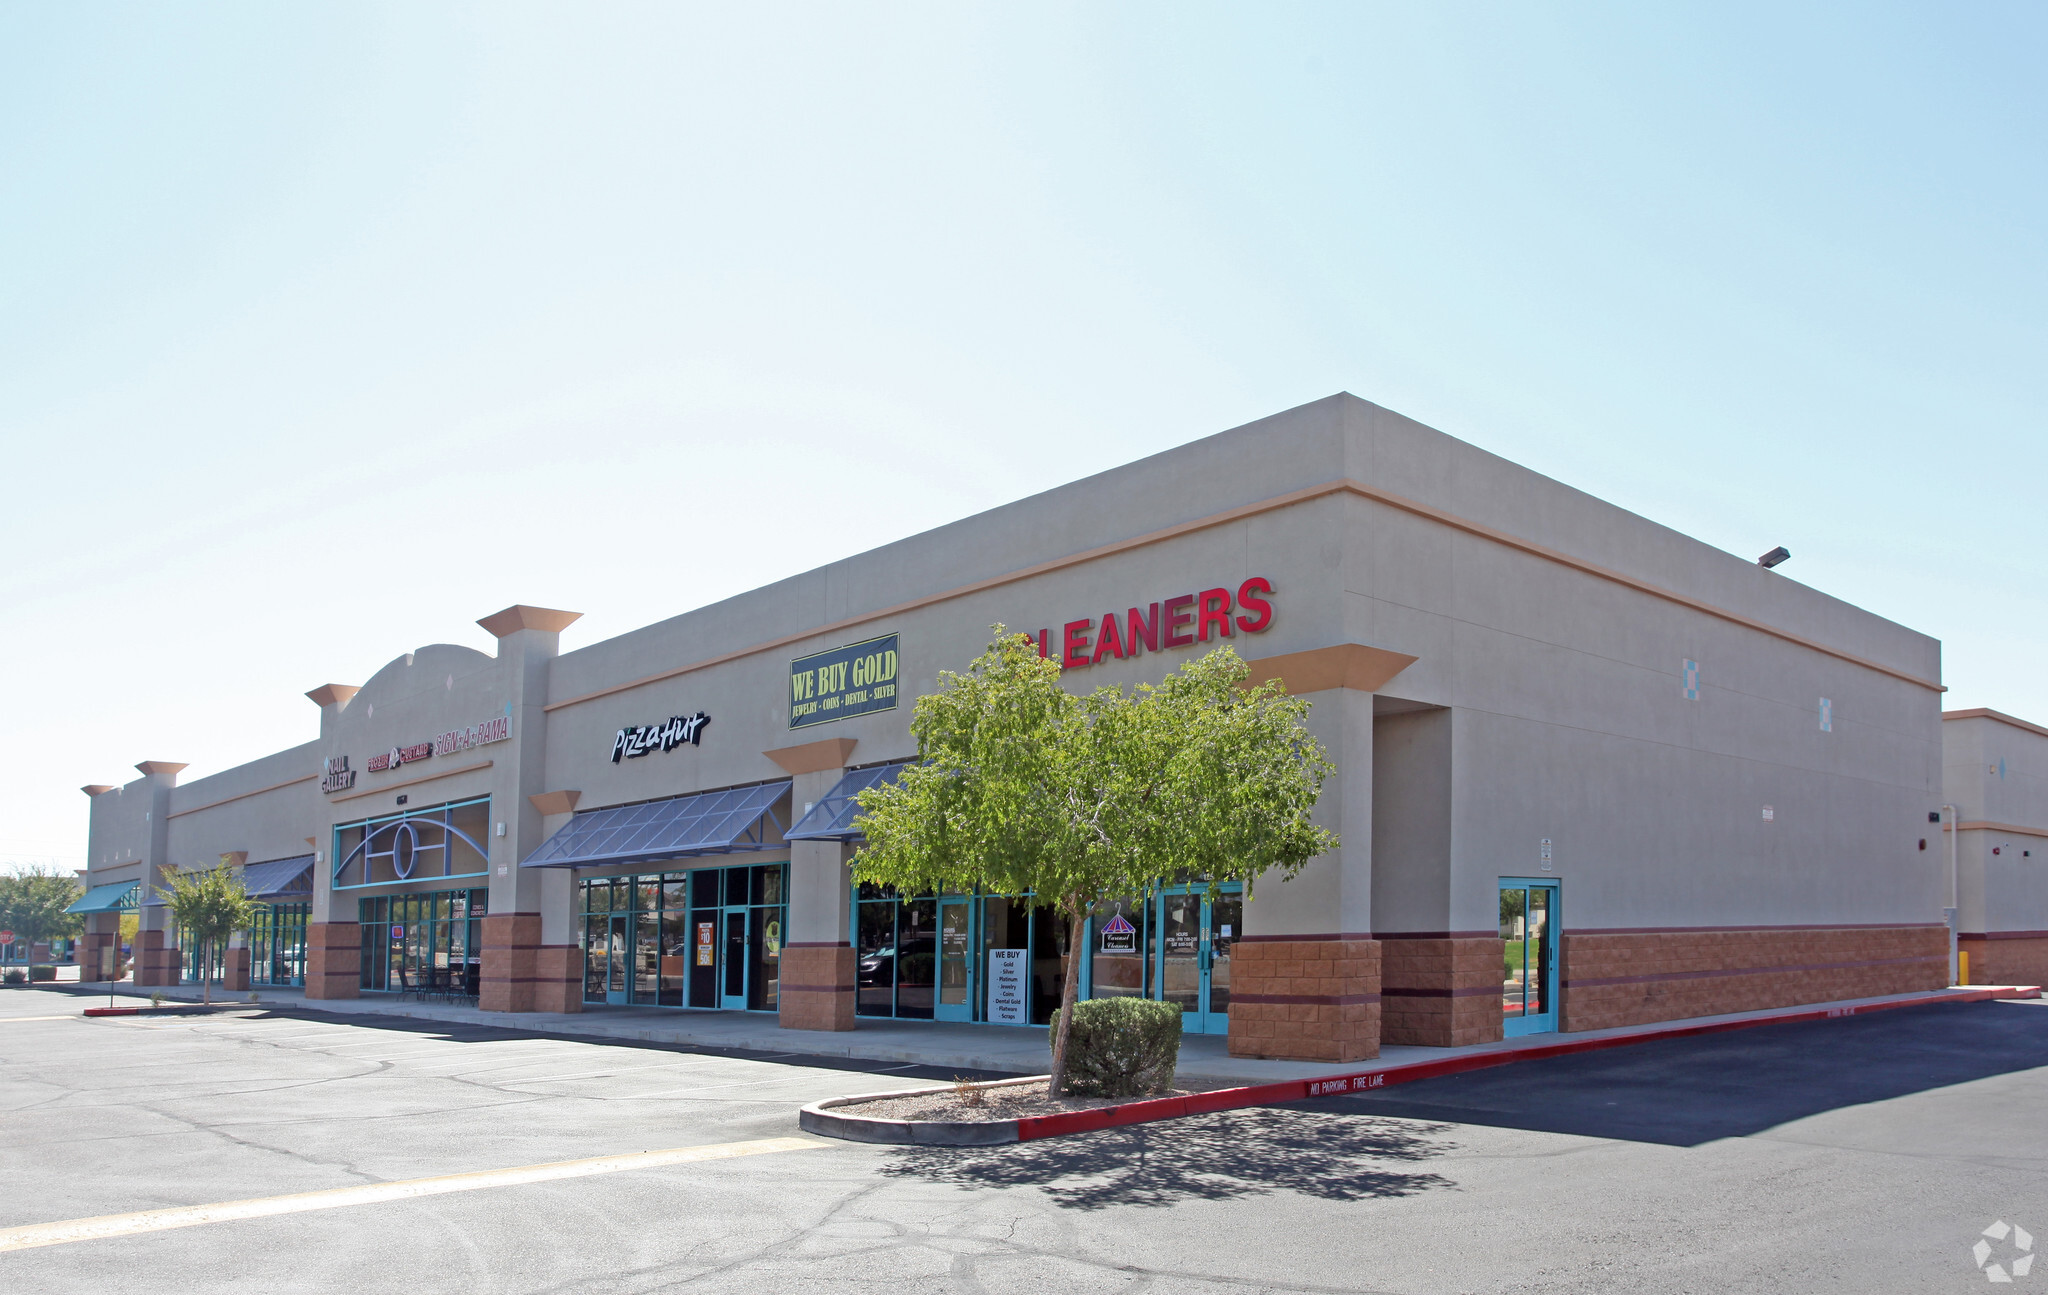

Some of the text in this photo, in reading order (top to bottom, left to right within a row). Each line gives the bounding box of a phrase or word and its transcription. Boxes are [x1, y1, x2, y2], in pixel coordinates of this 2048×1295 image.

[1006, 577, 1276, 678] EANERS
[792, 650, 897, 702] WE BUY GOLD
[792, 701, 818, 719] JEWELRY
[822, 696, 840, 711] COINS
[844, 690, 868, 706] DENTAL
[873, 684, 896, 700] SILVER
[434, 730, 459, 756] SIGN
[476, 716, 508, 746] RAMA
[328, 756, 349, 775] NAIL
[368, 743, 429, 770] FROZEN CUSTARD
[701, 932, 710, 944] $10
[1310, 1074, 1384, 1095] NO PARKING FIRE LANE
